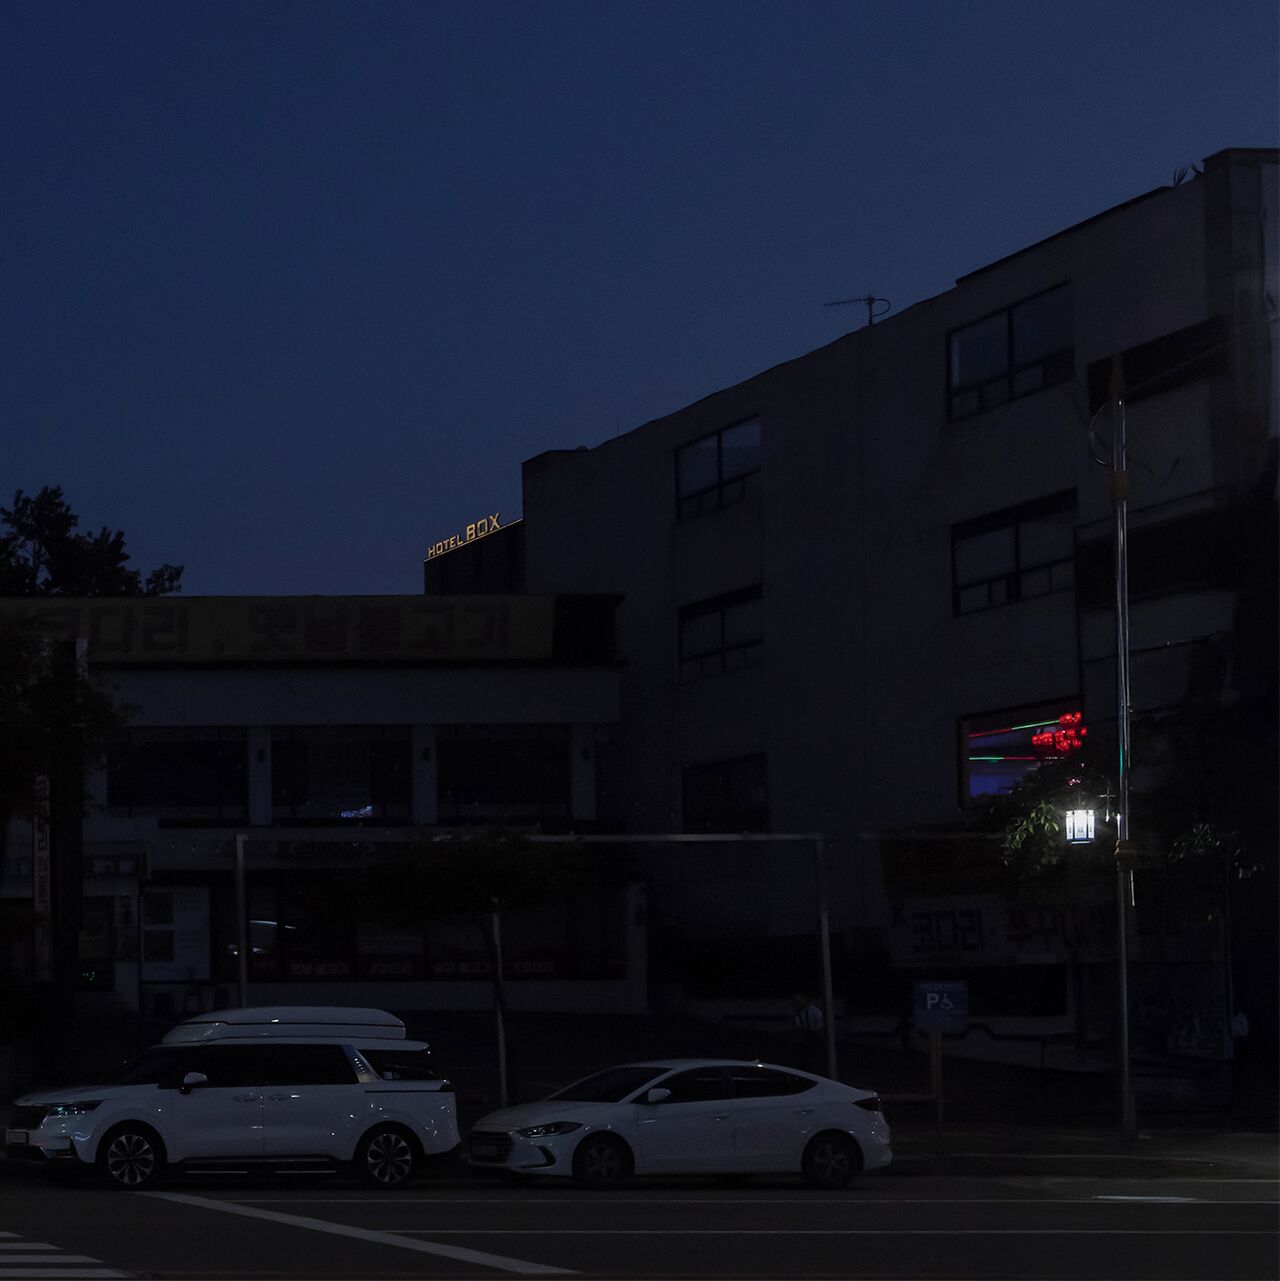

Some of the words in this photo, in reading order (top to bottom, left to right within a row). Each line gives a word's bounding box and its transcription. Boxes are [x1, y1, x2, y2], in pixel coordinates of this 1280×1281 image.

[427, 533, 464, 559] HOTEL
[465, 512, 501, 542] BOX
[926, 992, 940, 1010] P
